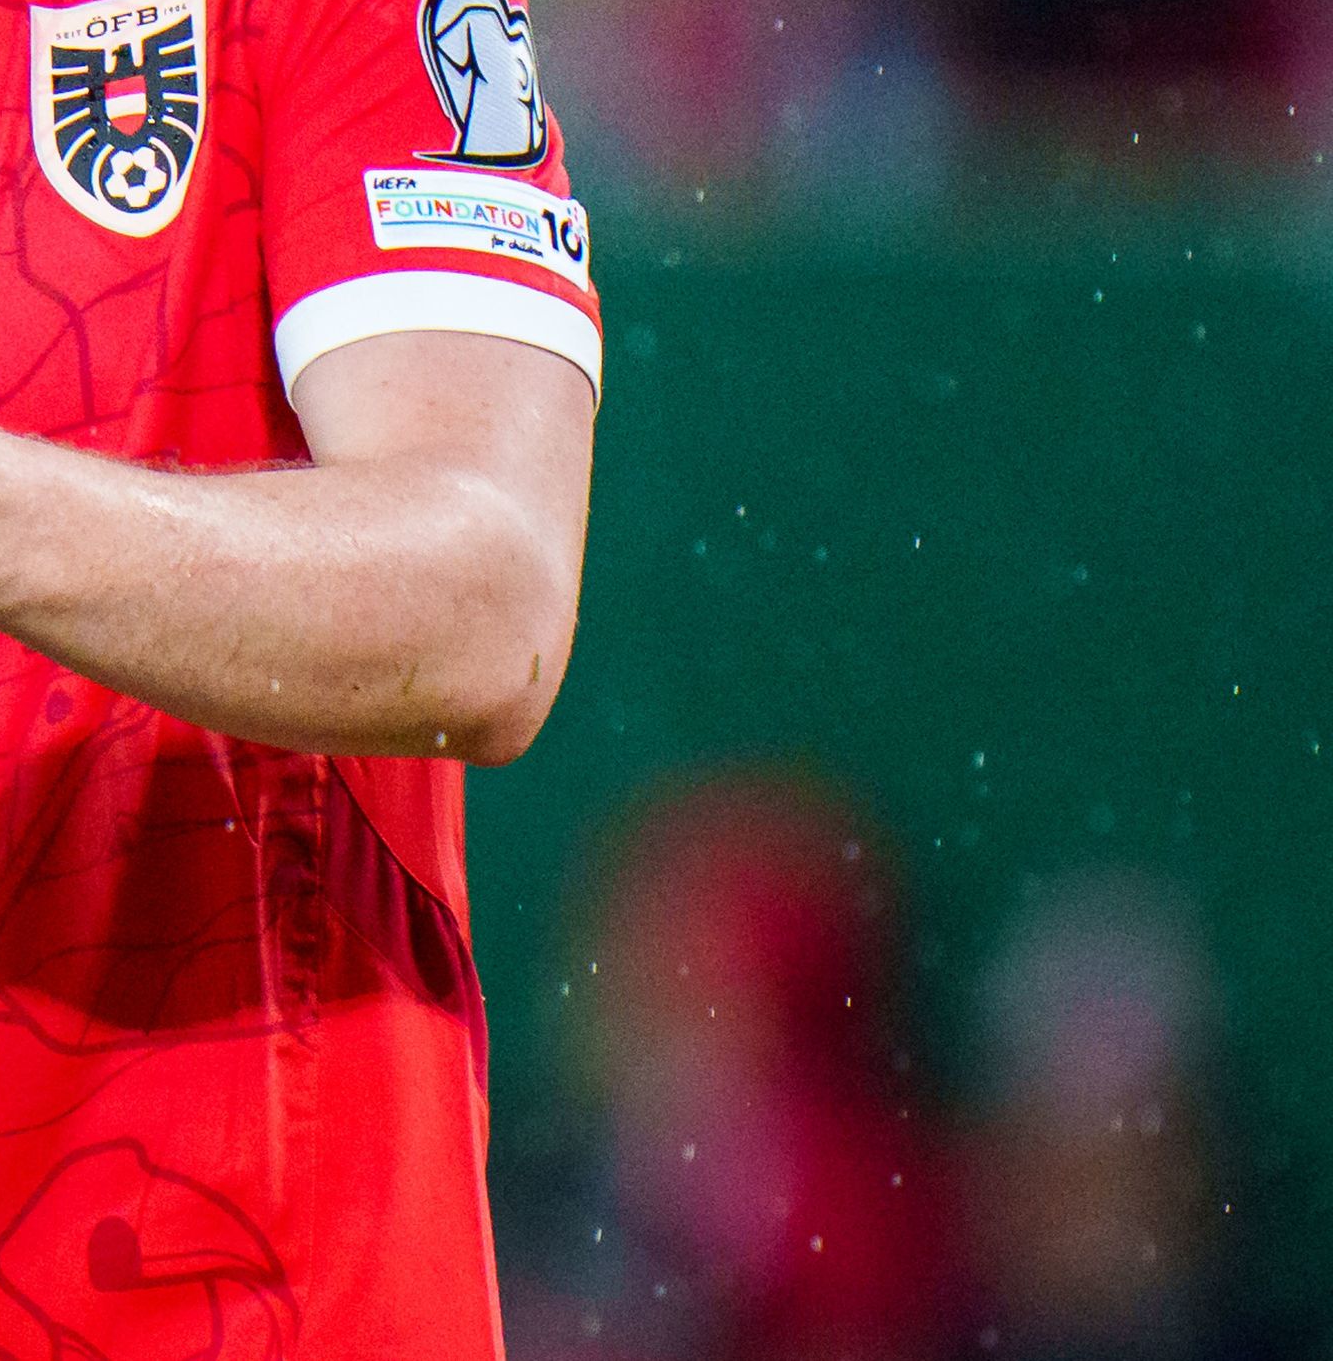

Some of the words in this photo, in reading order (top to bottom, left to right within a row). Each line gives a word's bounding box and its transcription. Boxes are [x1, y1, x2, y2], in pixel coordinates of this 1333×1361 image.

[86, 6, 159, 38] ÖFB
[373, 177, 416, 189] UEFA
[376, 199, 540, 236] FOUNDATION
